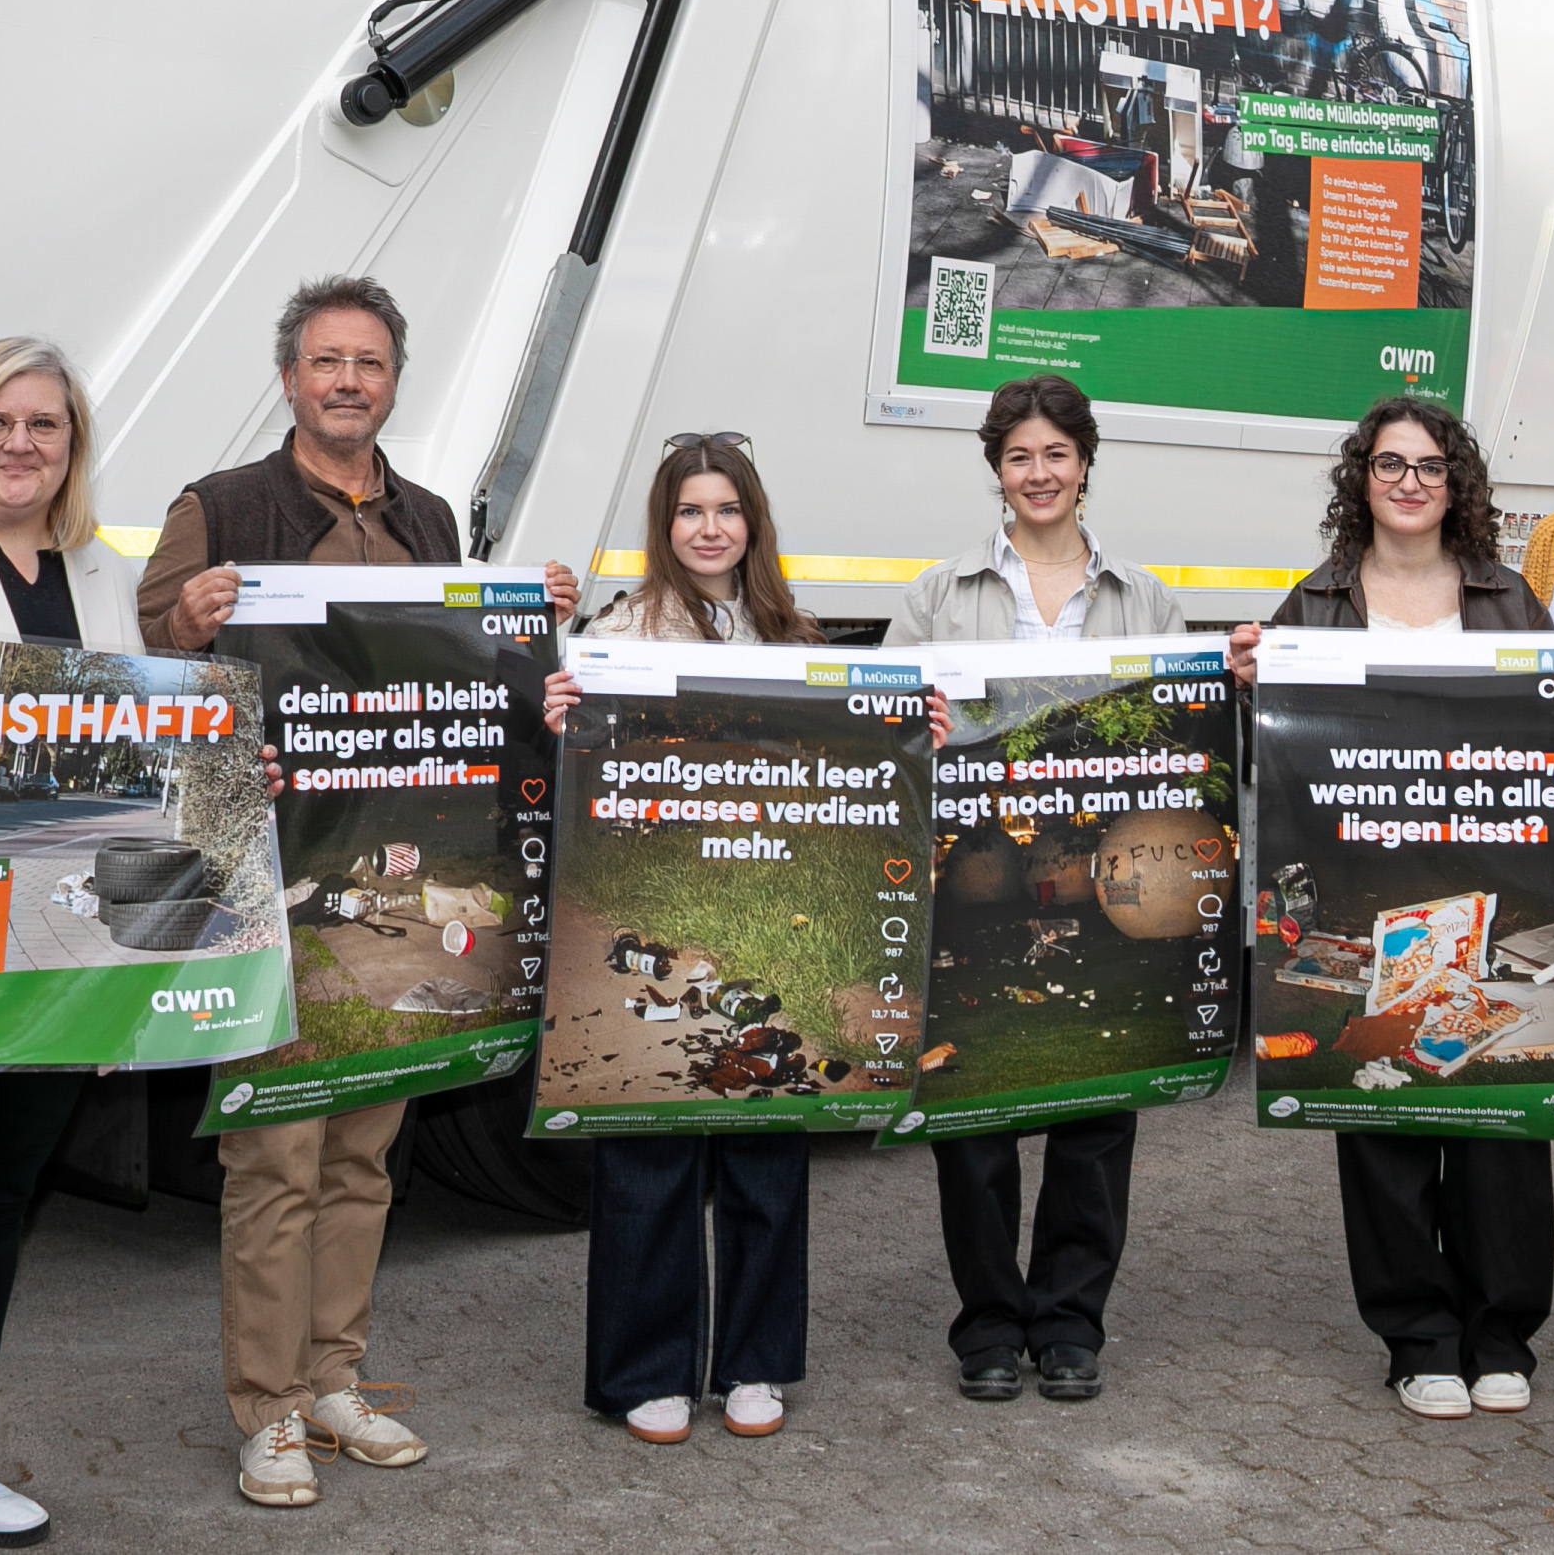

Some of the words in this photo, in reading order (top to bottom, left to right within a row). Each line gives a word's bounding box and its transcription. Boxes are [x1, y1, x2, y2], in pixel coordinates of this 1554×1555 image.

[1240, 96, 1250, 114] 7
[1252, 101, 1287, 117] neue
[1288, 101, 1324, 122] wilde
[1326, 105, 1439, 133] Müllablagerungen
[1243, 131, 1267, 149] pro
[1268, 129, 1298, 153] Tag.
[1300, 131, 1328, 152] Eine
[1330, 135, 1385, 155] einfache
[1387, 137, 1434, 161] Lösung.
[1380, 345, 1435, 374] awm
[448, 590, 479, 603] STADT
[495, 589, 541, 604] MÜNSTER
[481, 614, 548, 635] awm
[1115, 662, 1149, 675] STADT
[1168, 657, 1220, 672] MÜNSTER
[1499, 656, 1537, 668] STADT
[809, 670, 846, 683] STADT
[864, 668, 918, 685] MÜNSTER
[279, 683, 348, 715] dein
[356, 682, 419, 712] müll
[425, 681, 509, 711] bleibt
[1152, 680, 1226, 704] awm
[847, 692, 923, 717] awm
[283, 722, 387, 759] länger
[394, 719, 436, 749] als
[442, 717, 505, 748] dein
[1012, 747, 1206, 784] schnapsidee
[1330, 747, 1442, 770] warum
[601, 755, 810, 790] spaßgetränk
[817, 758, 896, 789] leer?
[999, 787, 1074, 816] noch
[1082, 790, 1130, 814] am
[1137, 782, 1204, 810] ufer.
[1309, 782, 1401, 805] wenn
[1404, 779, 1447, 806] du
[1454, 779, 1494, 806] eh
[517, 812, 533, 822] 94,1
[534, 811, 551, 821] Tsd.
[595, 791, 651, 820] der
[658, 798, 760, 822] aasee
[765, 796, 900, 826] verdient
[1342, 813, 1443, 848] liegen
[1449, 813, 1544, 844] lässt?
[701, 832, 793, 860] mehr.
[1211, 869, 1229, 879] Tsd.
[877, 892, 896, 902] 94,1
[897, 891, 917, 902] Tsd.
[1202, 923, 1218, 933] 987
[885, 948, 902, 957] 987
[151, 986, 236, 1013] awm
[193, 1020, 209, 1031] alle
[871, 1009, 888, 1020] 13,7
[890, 1009, 910, 1019] Tsd.
[1207, 1029, 1225, 1039] Tsd.
[885, 1059, 904, 1069] Tsd.
